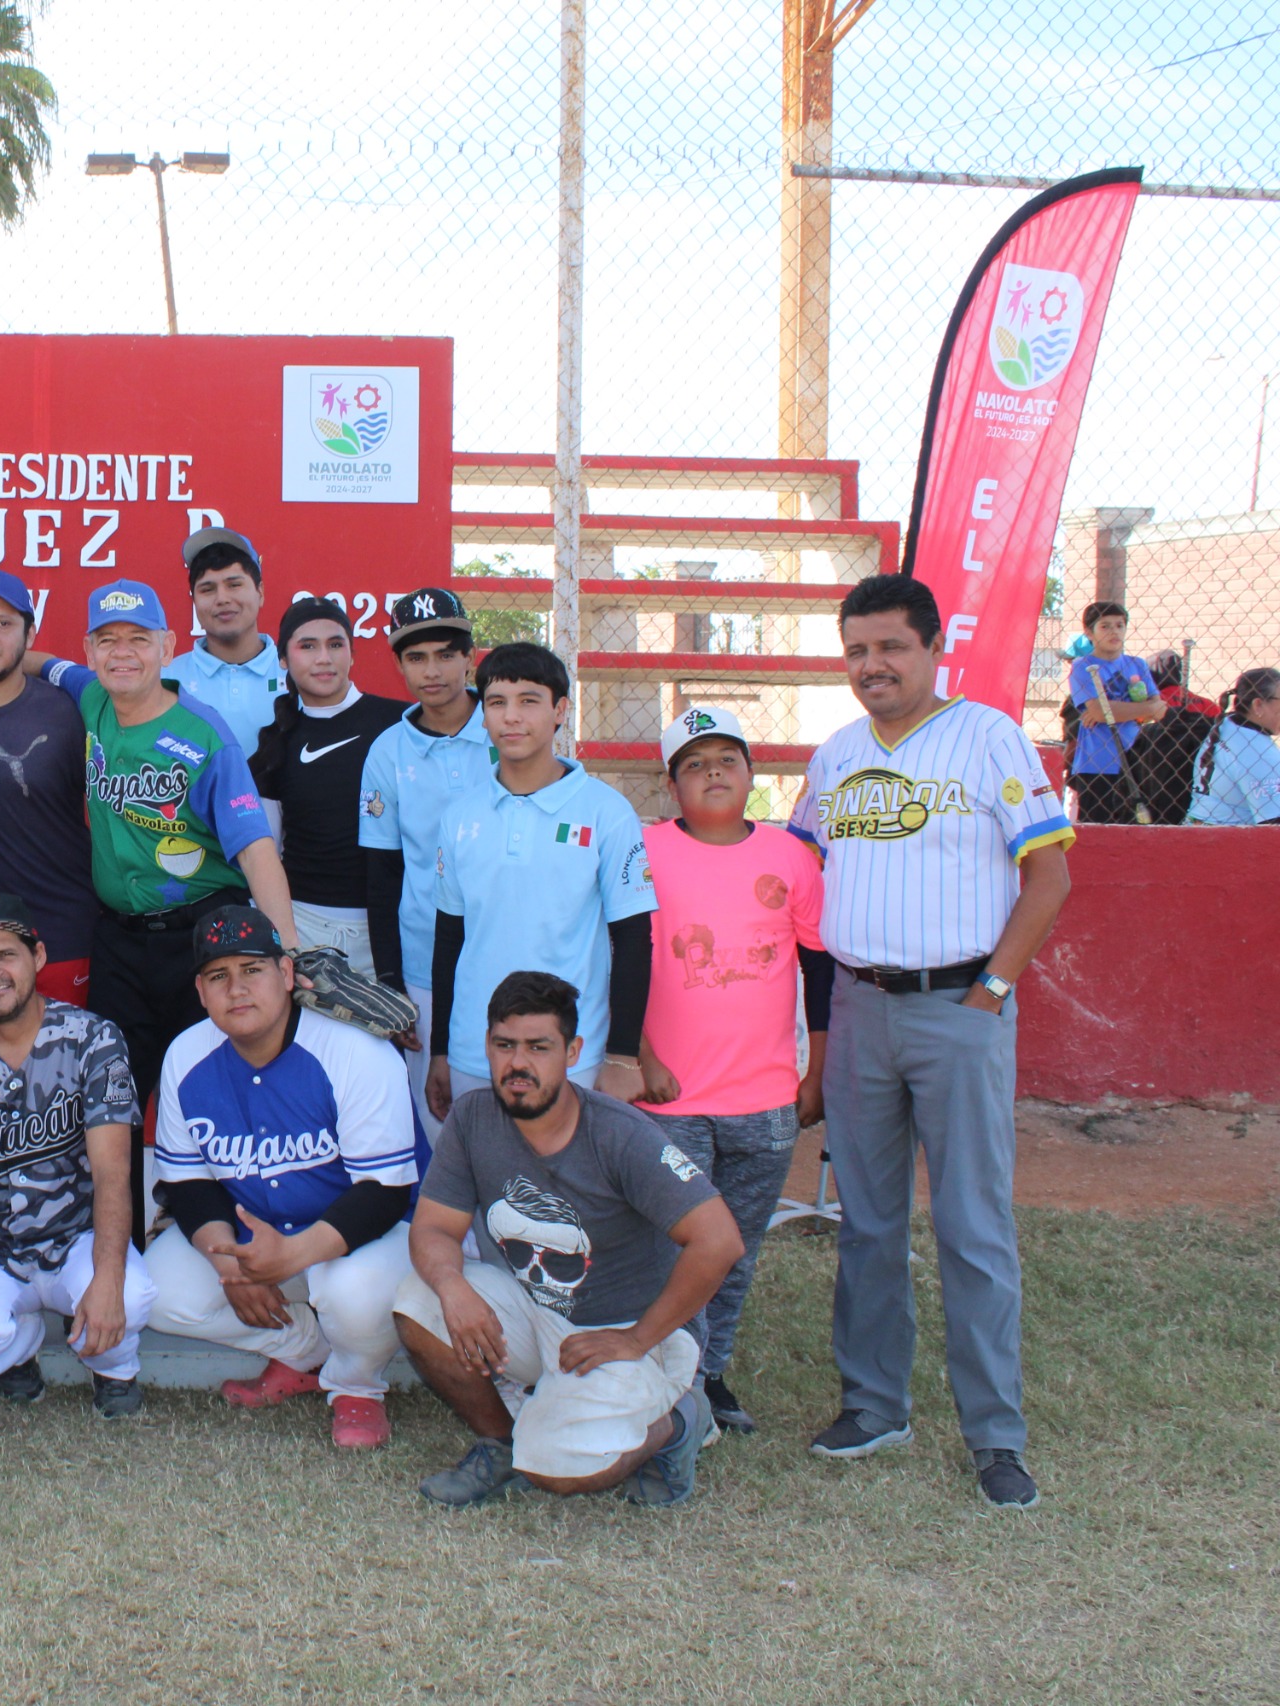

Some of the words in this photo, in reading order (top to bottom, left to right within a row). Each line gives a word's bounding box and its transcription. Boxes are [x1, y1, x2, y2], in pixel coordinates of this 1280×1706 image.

[974, 408, 984, 419] EL
[984, 410, 1015, 423] FUTURO
[986, 426, 1036, 441] 2024-2027
[308, 462, 392, 475] NAVOLATO
[308, 474, 319, 482] EL
[320, 474, 355, 482] FUTURO
[371, 475, 392, 483] HOY!
[325, 484, 373, 494] 2024-2027
[413, 594, 436, 618] NY
[85, 762, 188, 814] Payasos
[818, 776, 970, 823] SINALOA
[124, 811, 186, 832] Navolato
[621, 841, 646, 885] LONCHER
[185, 1116, 339, 1181] Payasos
